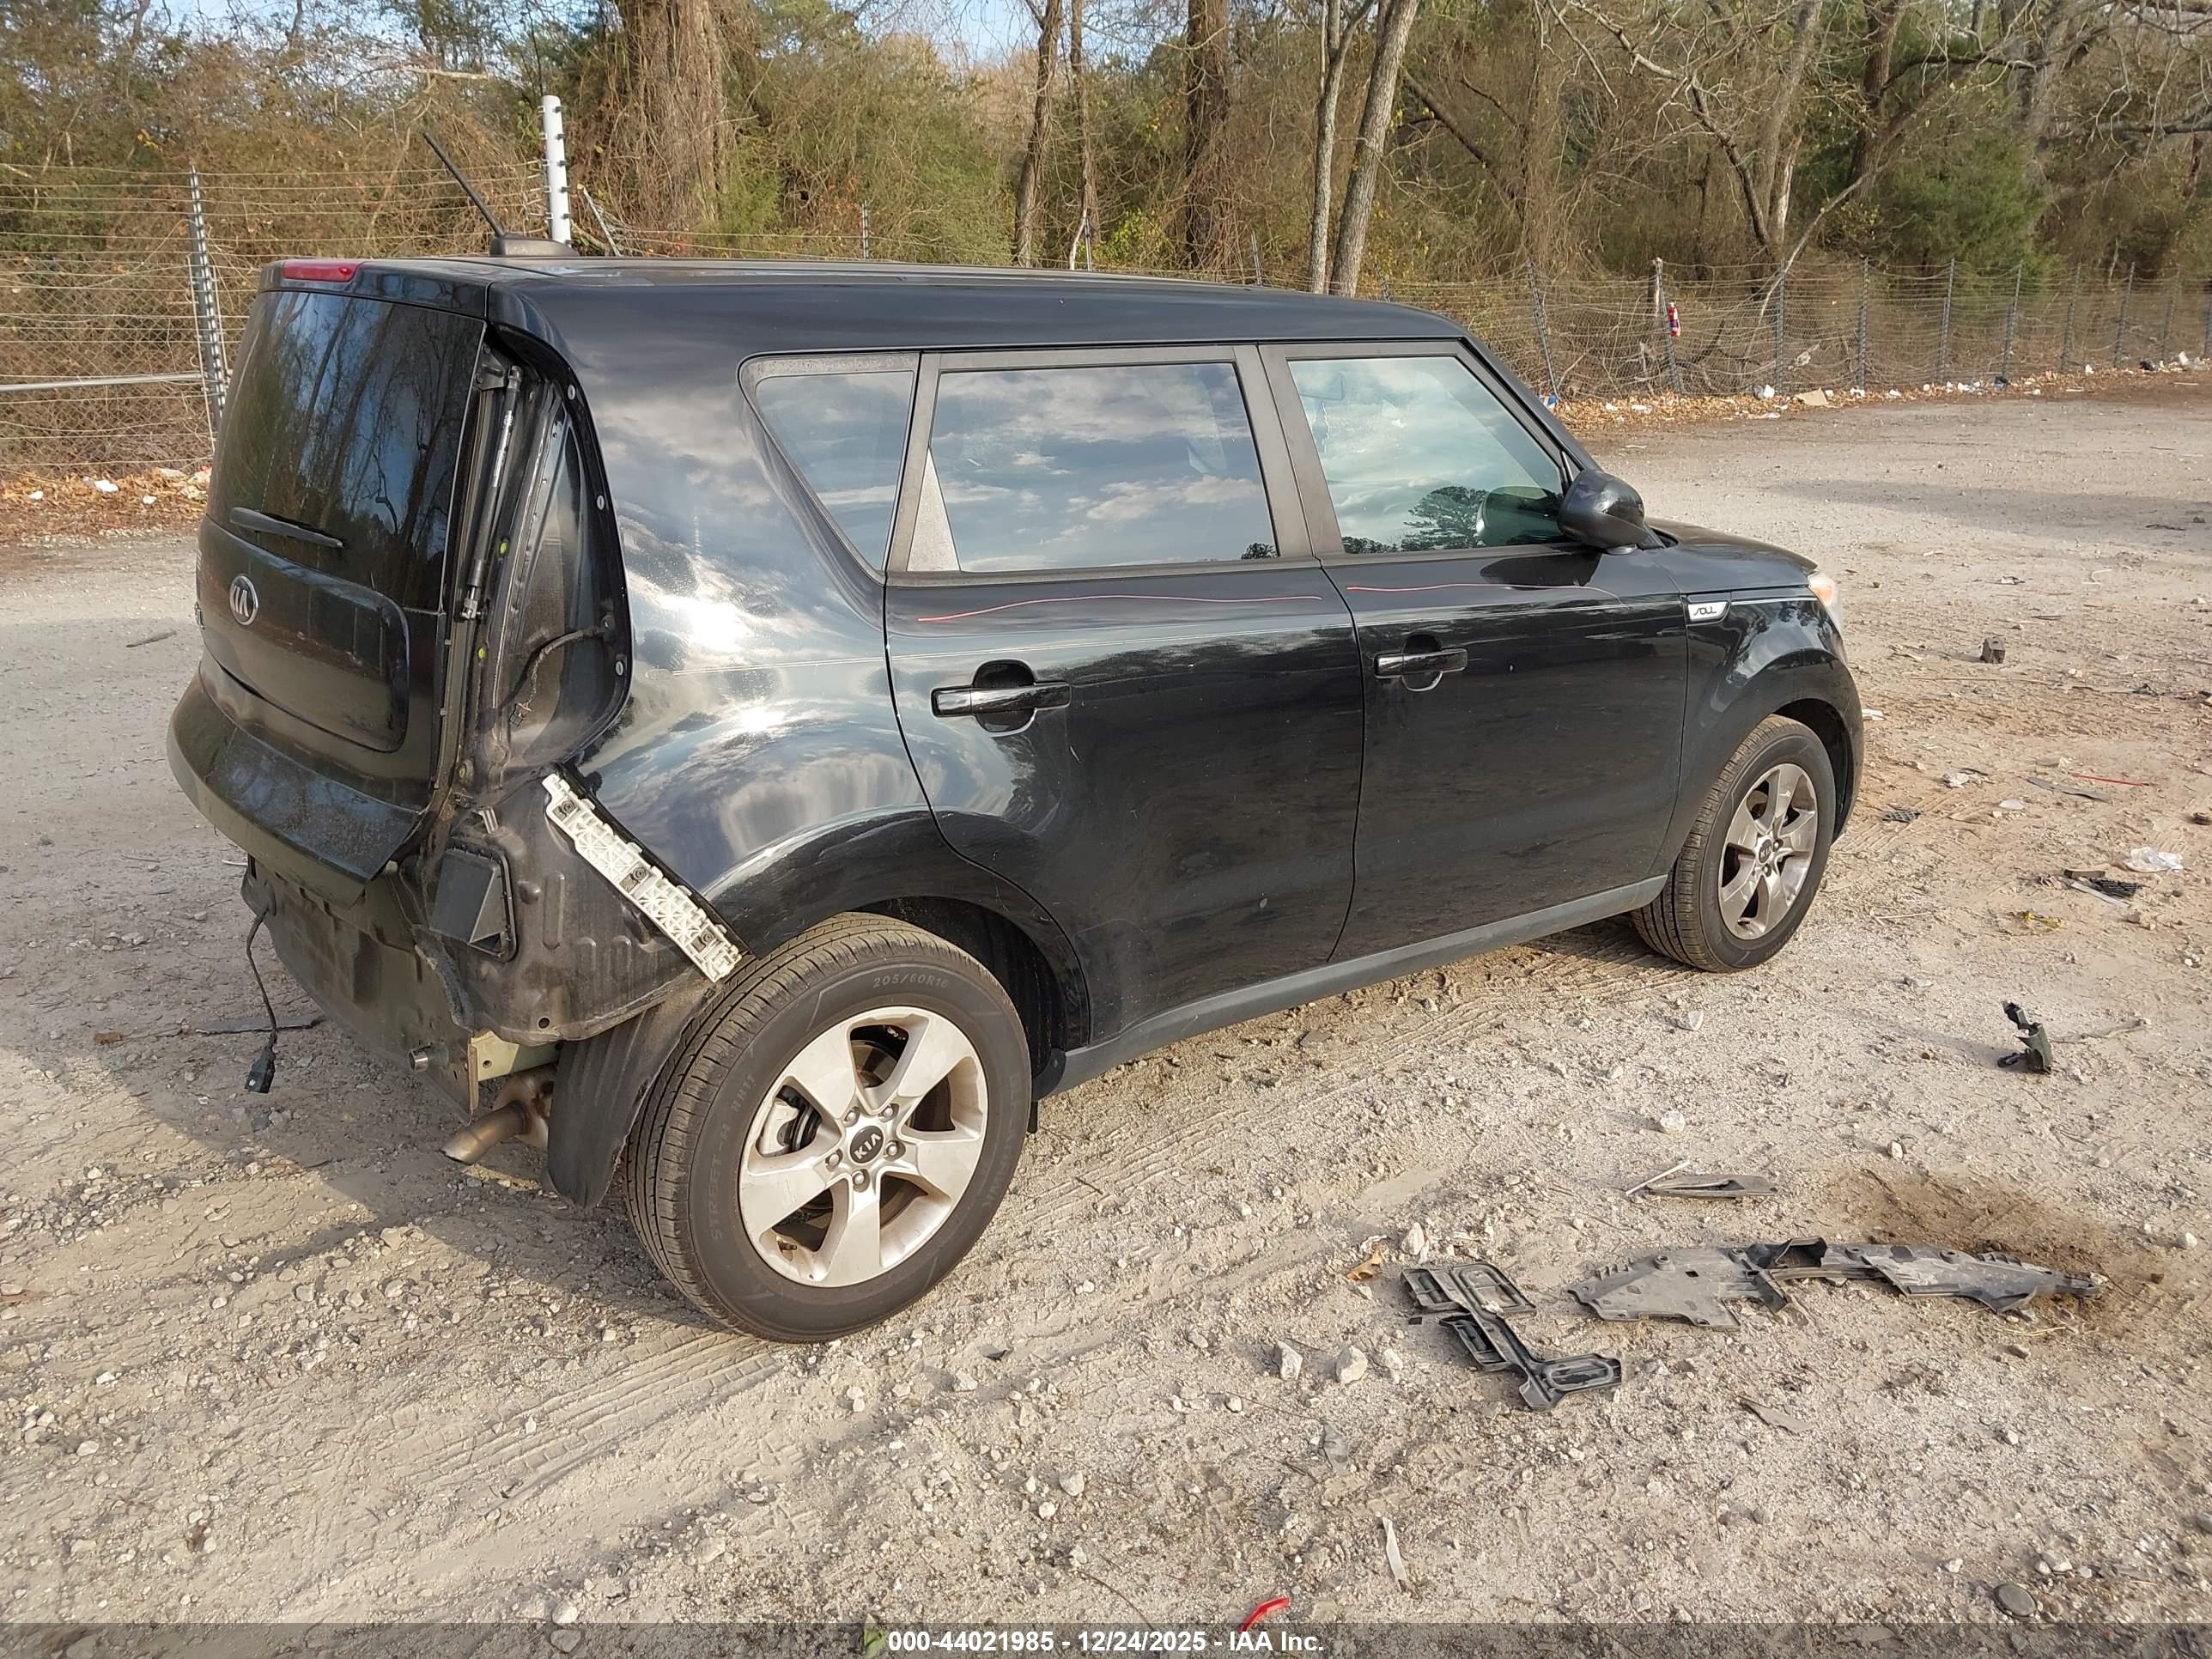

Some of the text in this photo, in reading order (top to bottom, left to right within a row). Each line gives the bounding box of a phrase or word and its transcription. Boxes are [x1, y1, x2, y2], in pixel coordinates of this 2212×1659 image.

[1693, 606, 1717, 616] SOUL
[872, 972, 949, 988] 205/60R16
[854, 1133, 882, 1159] KIA
